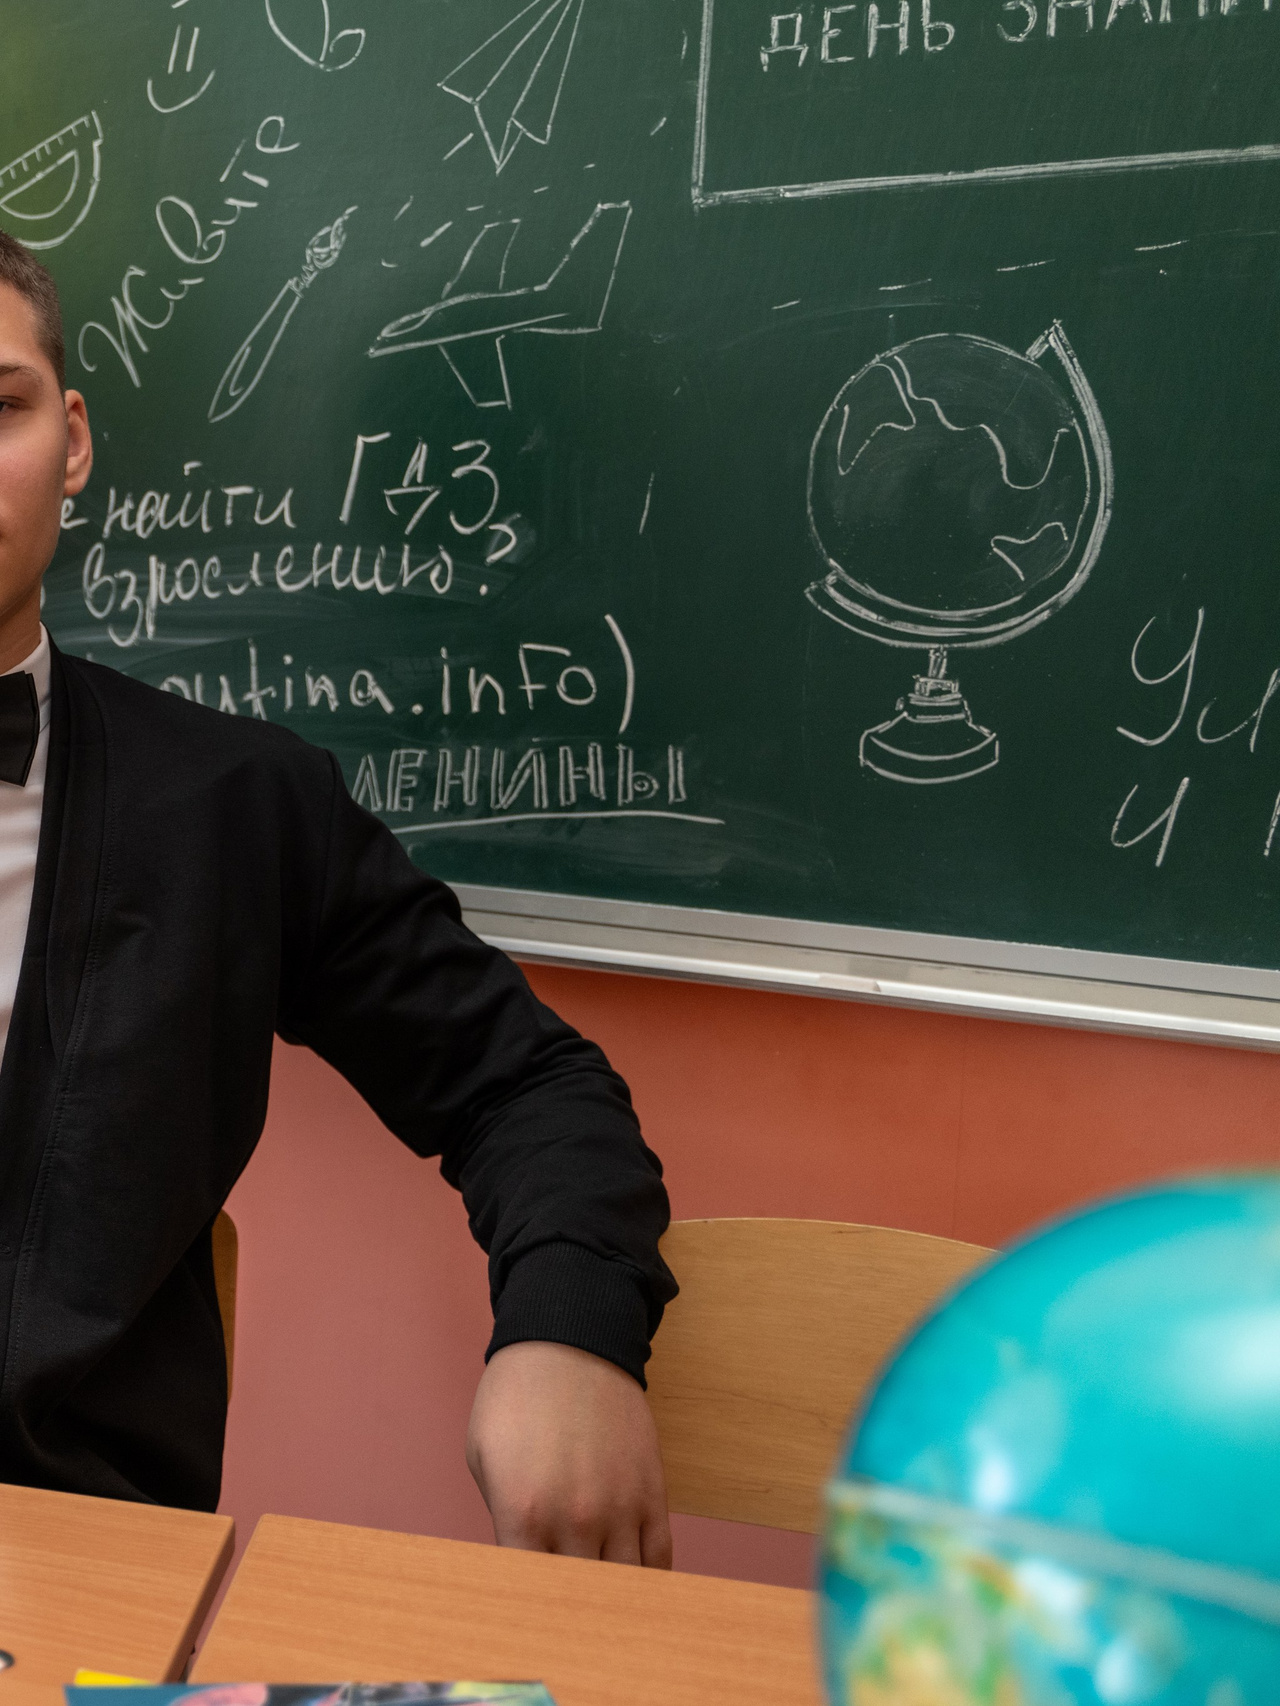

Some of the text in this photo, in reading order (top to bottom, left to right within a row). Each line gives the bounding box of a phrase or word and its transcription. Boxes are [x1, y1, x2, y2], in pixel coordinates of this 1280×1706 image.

[760, 0, 956, 72] ДЕНЬ
[77, 115, 302, 388] Живите
[102, 460, 298, 539] найти
[338, 431, 500, 535] ГДЗ
